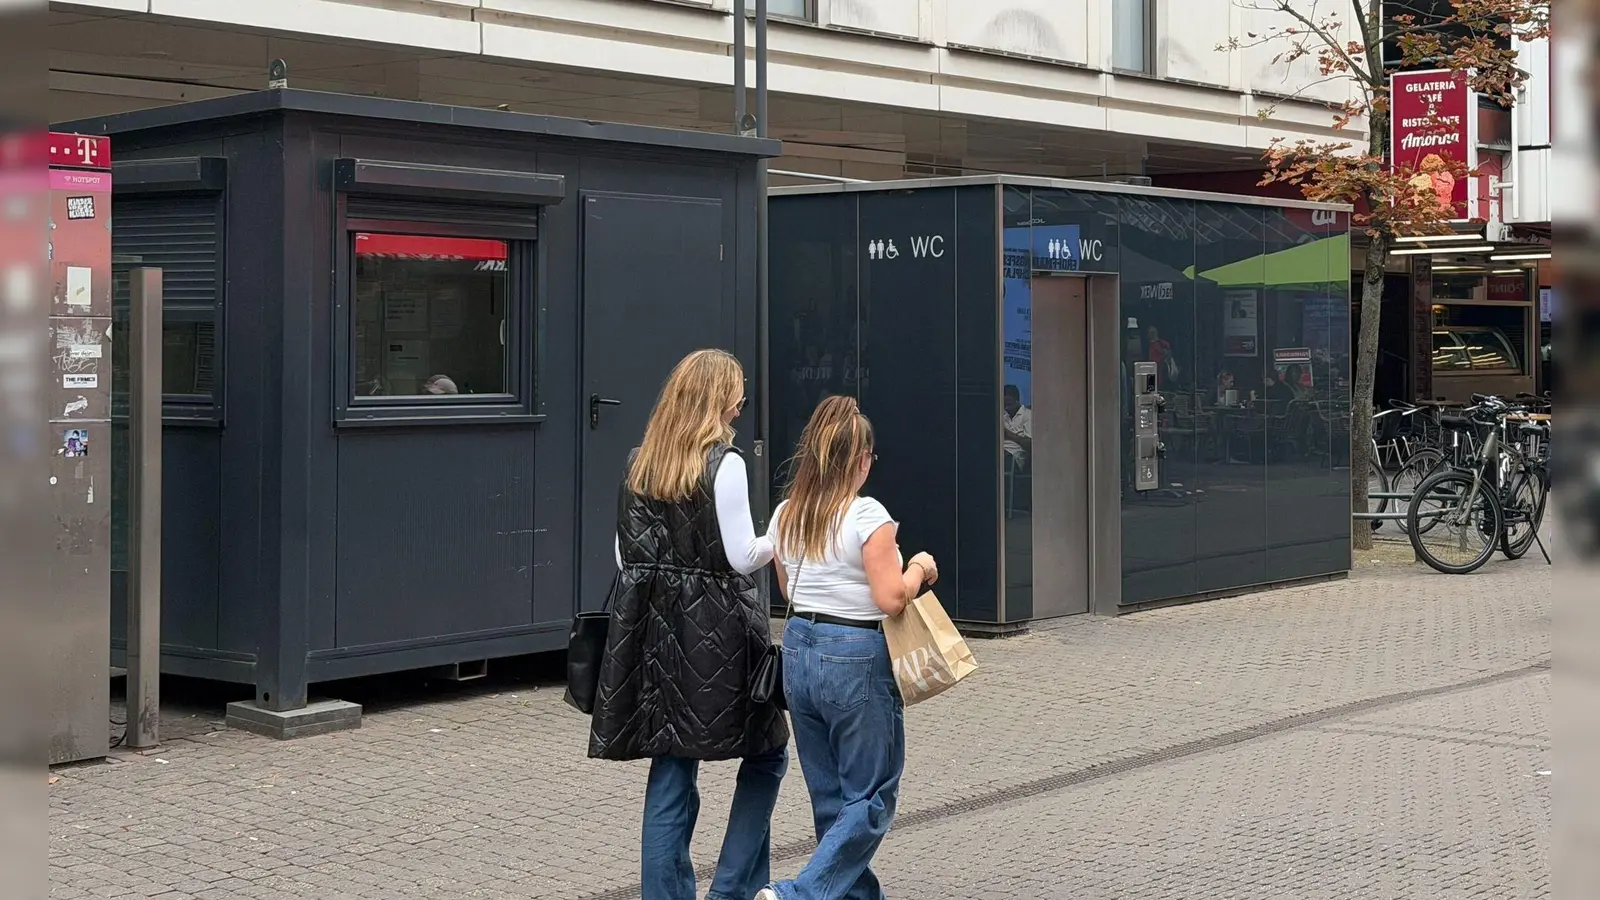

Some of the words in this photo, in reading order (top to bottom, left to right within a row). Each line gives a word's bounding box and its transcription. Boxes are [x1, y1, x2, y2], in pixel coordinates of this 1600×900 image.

[1405, 80, 1456, 92] GELATERIA
[1402, 115, 1460, 128] RISTOANTE
[72, 176, 101, 184] HOTSPOT
[910, 235, 944, 258] WC
[1079, 239, 1102, 262] WC
